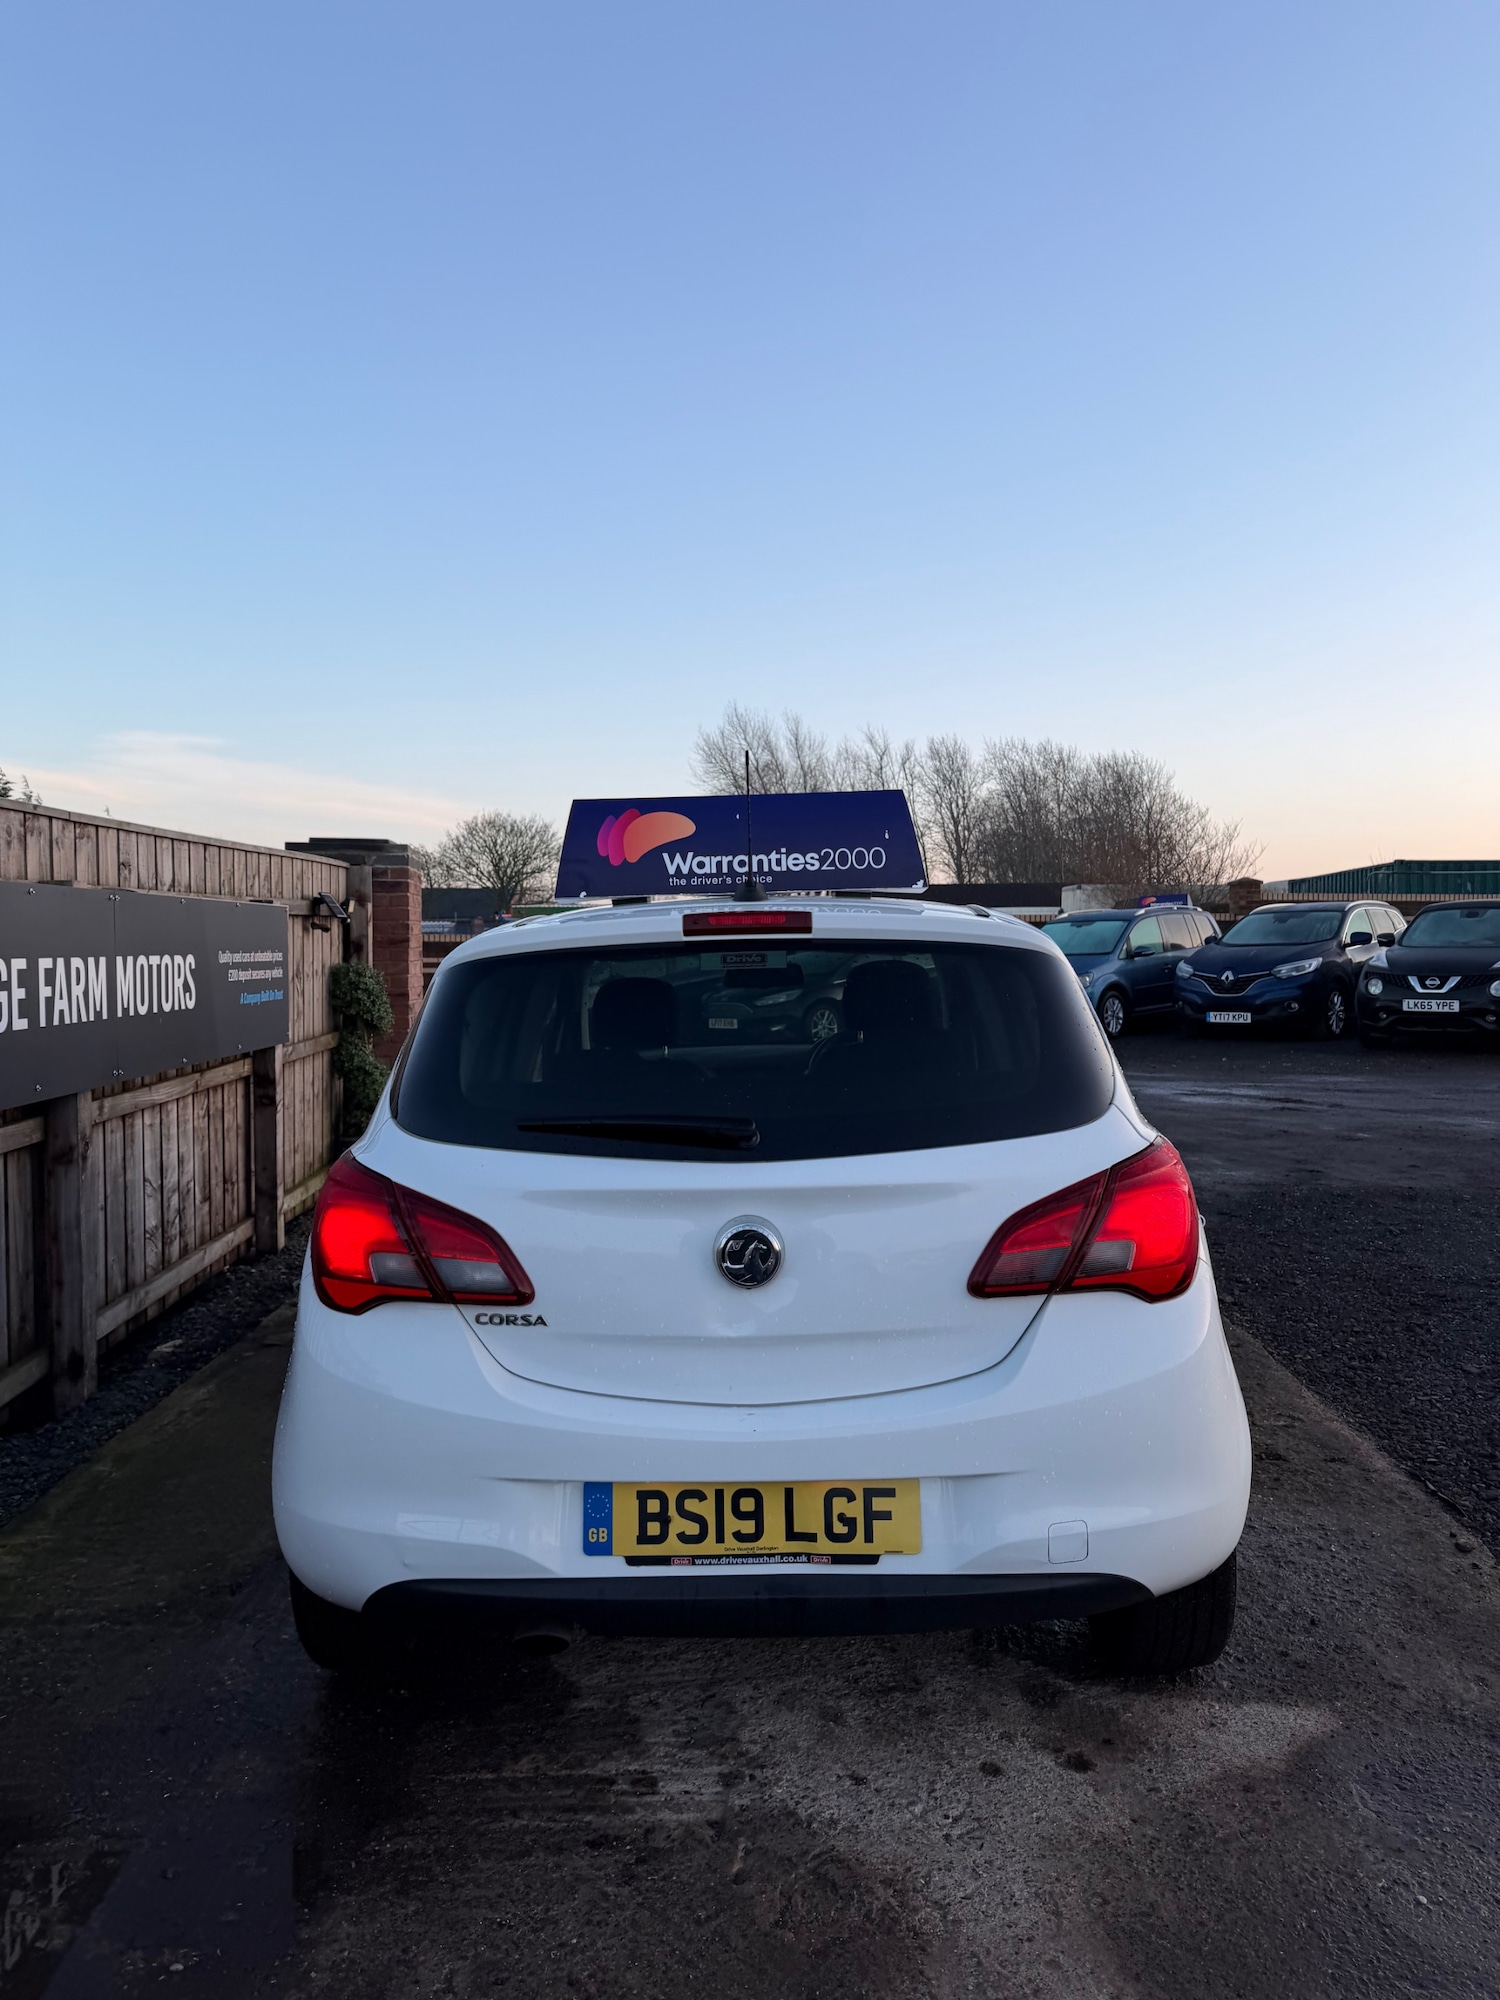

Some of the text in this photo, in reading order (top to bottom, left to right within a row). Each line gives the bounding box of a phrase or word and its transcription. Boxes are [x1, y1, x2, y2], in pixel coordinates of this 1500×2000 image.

[662, 847, 886, 875] Warranties2000
[669, 877, 687, 886] the
[691, 875, 733, 886] driver's
[218, 950, 232, 965] Quality
[233, 950, 242, 963] used
[726, 954, 762, 963] Drive
[239, 968, 252, 983] deposit
[38, 956, 108, 1027] FARM
[116, 953, 196, 1018] MOTORS
[1407, 1000, 1455, 1011] LK65 YPE
[1213, 1013, 1248, 1022] YT17 KPU
[474, 1312, 548, 1327] CORSA
[636, 1487, 896, 1545] BS19 LGF
[588, 1527, 608, 1543] GB
[695, 1555, 808, 1565] www.drivevauxhall.co.uk
[813, 1556, 829, 1564] Drive
